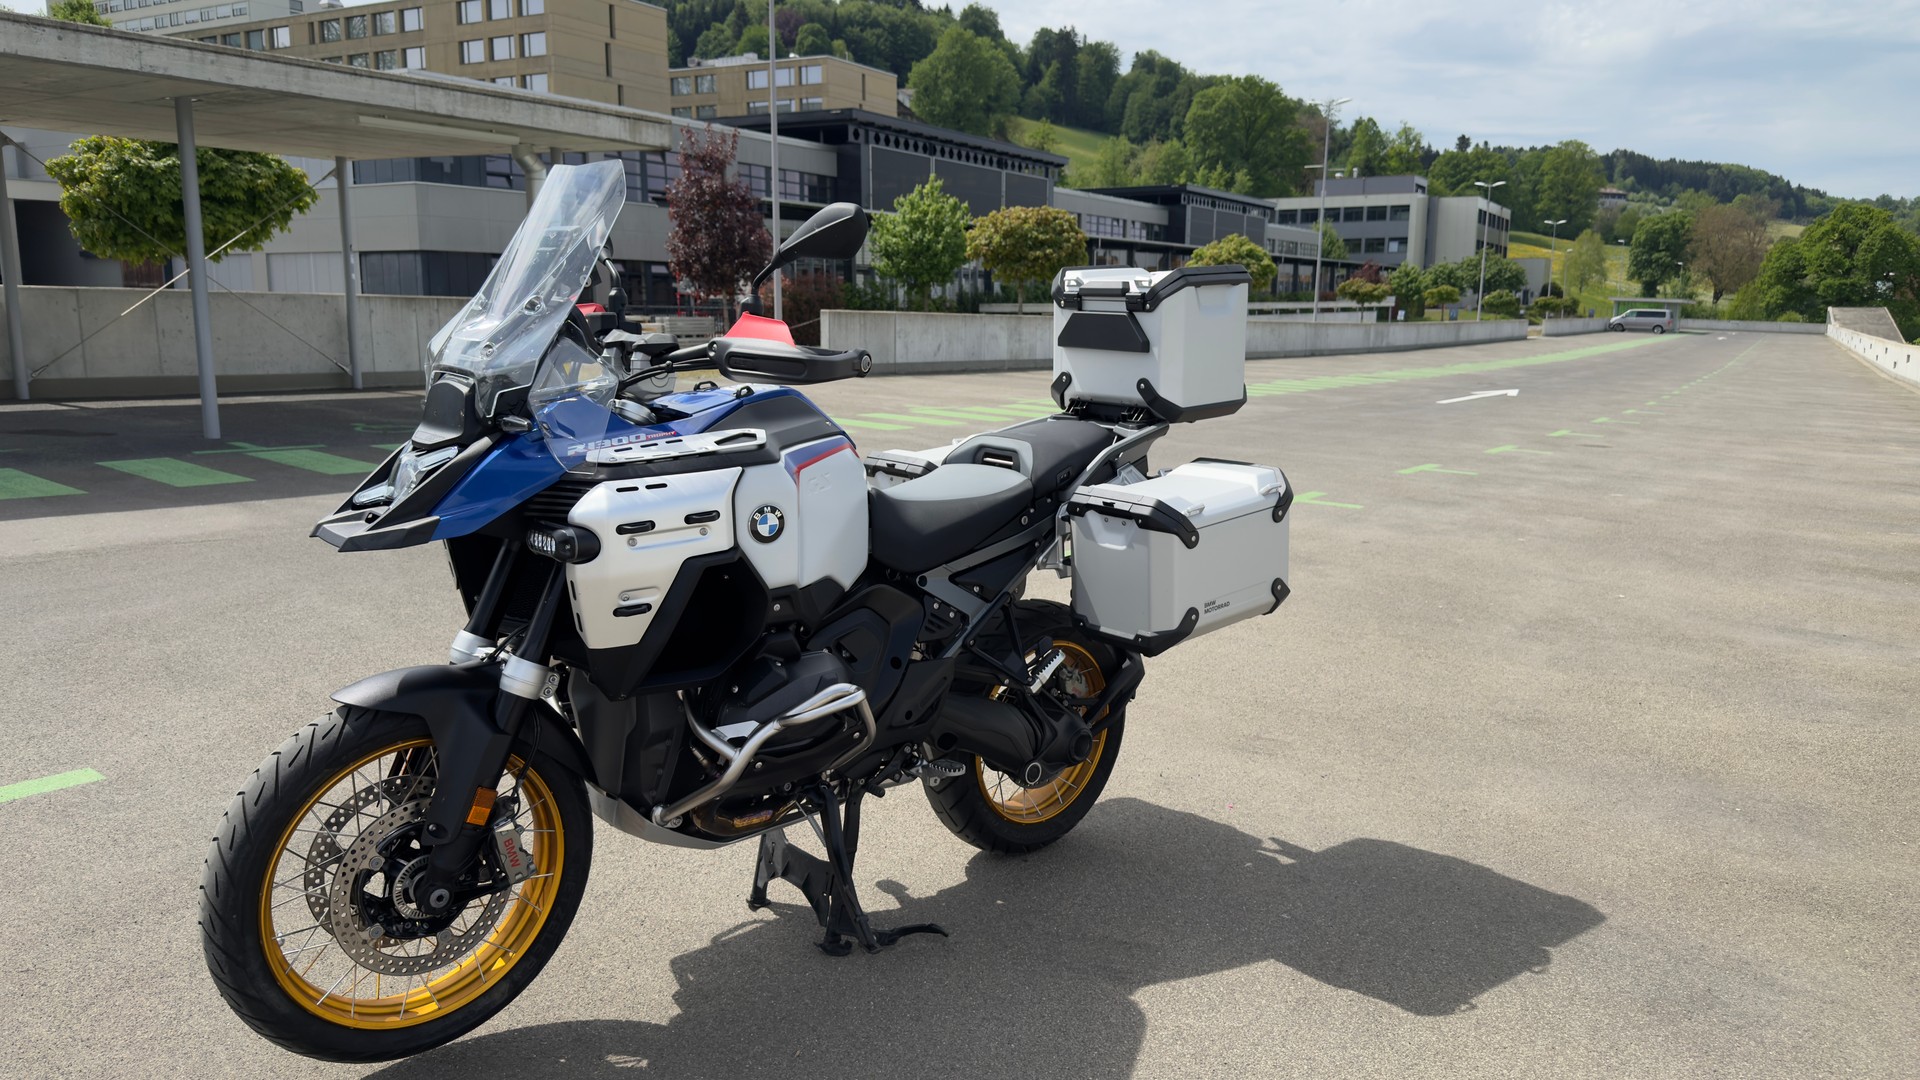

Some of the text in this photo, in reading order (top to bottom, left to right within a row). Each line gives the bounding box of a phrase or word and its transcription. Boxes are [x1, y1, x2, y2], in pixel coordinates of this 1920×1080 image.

[753, 506, 782, 521] BMW
[1204, 600, 1216, 608] BMW
[1204, 601, 1230, 614] MOTORRAD
[503, 837, 521, 868] BMW
